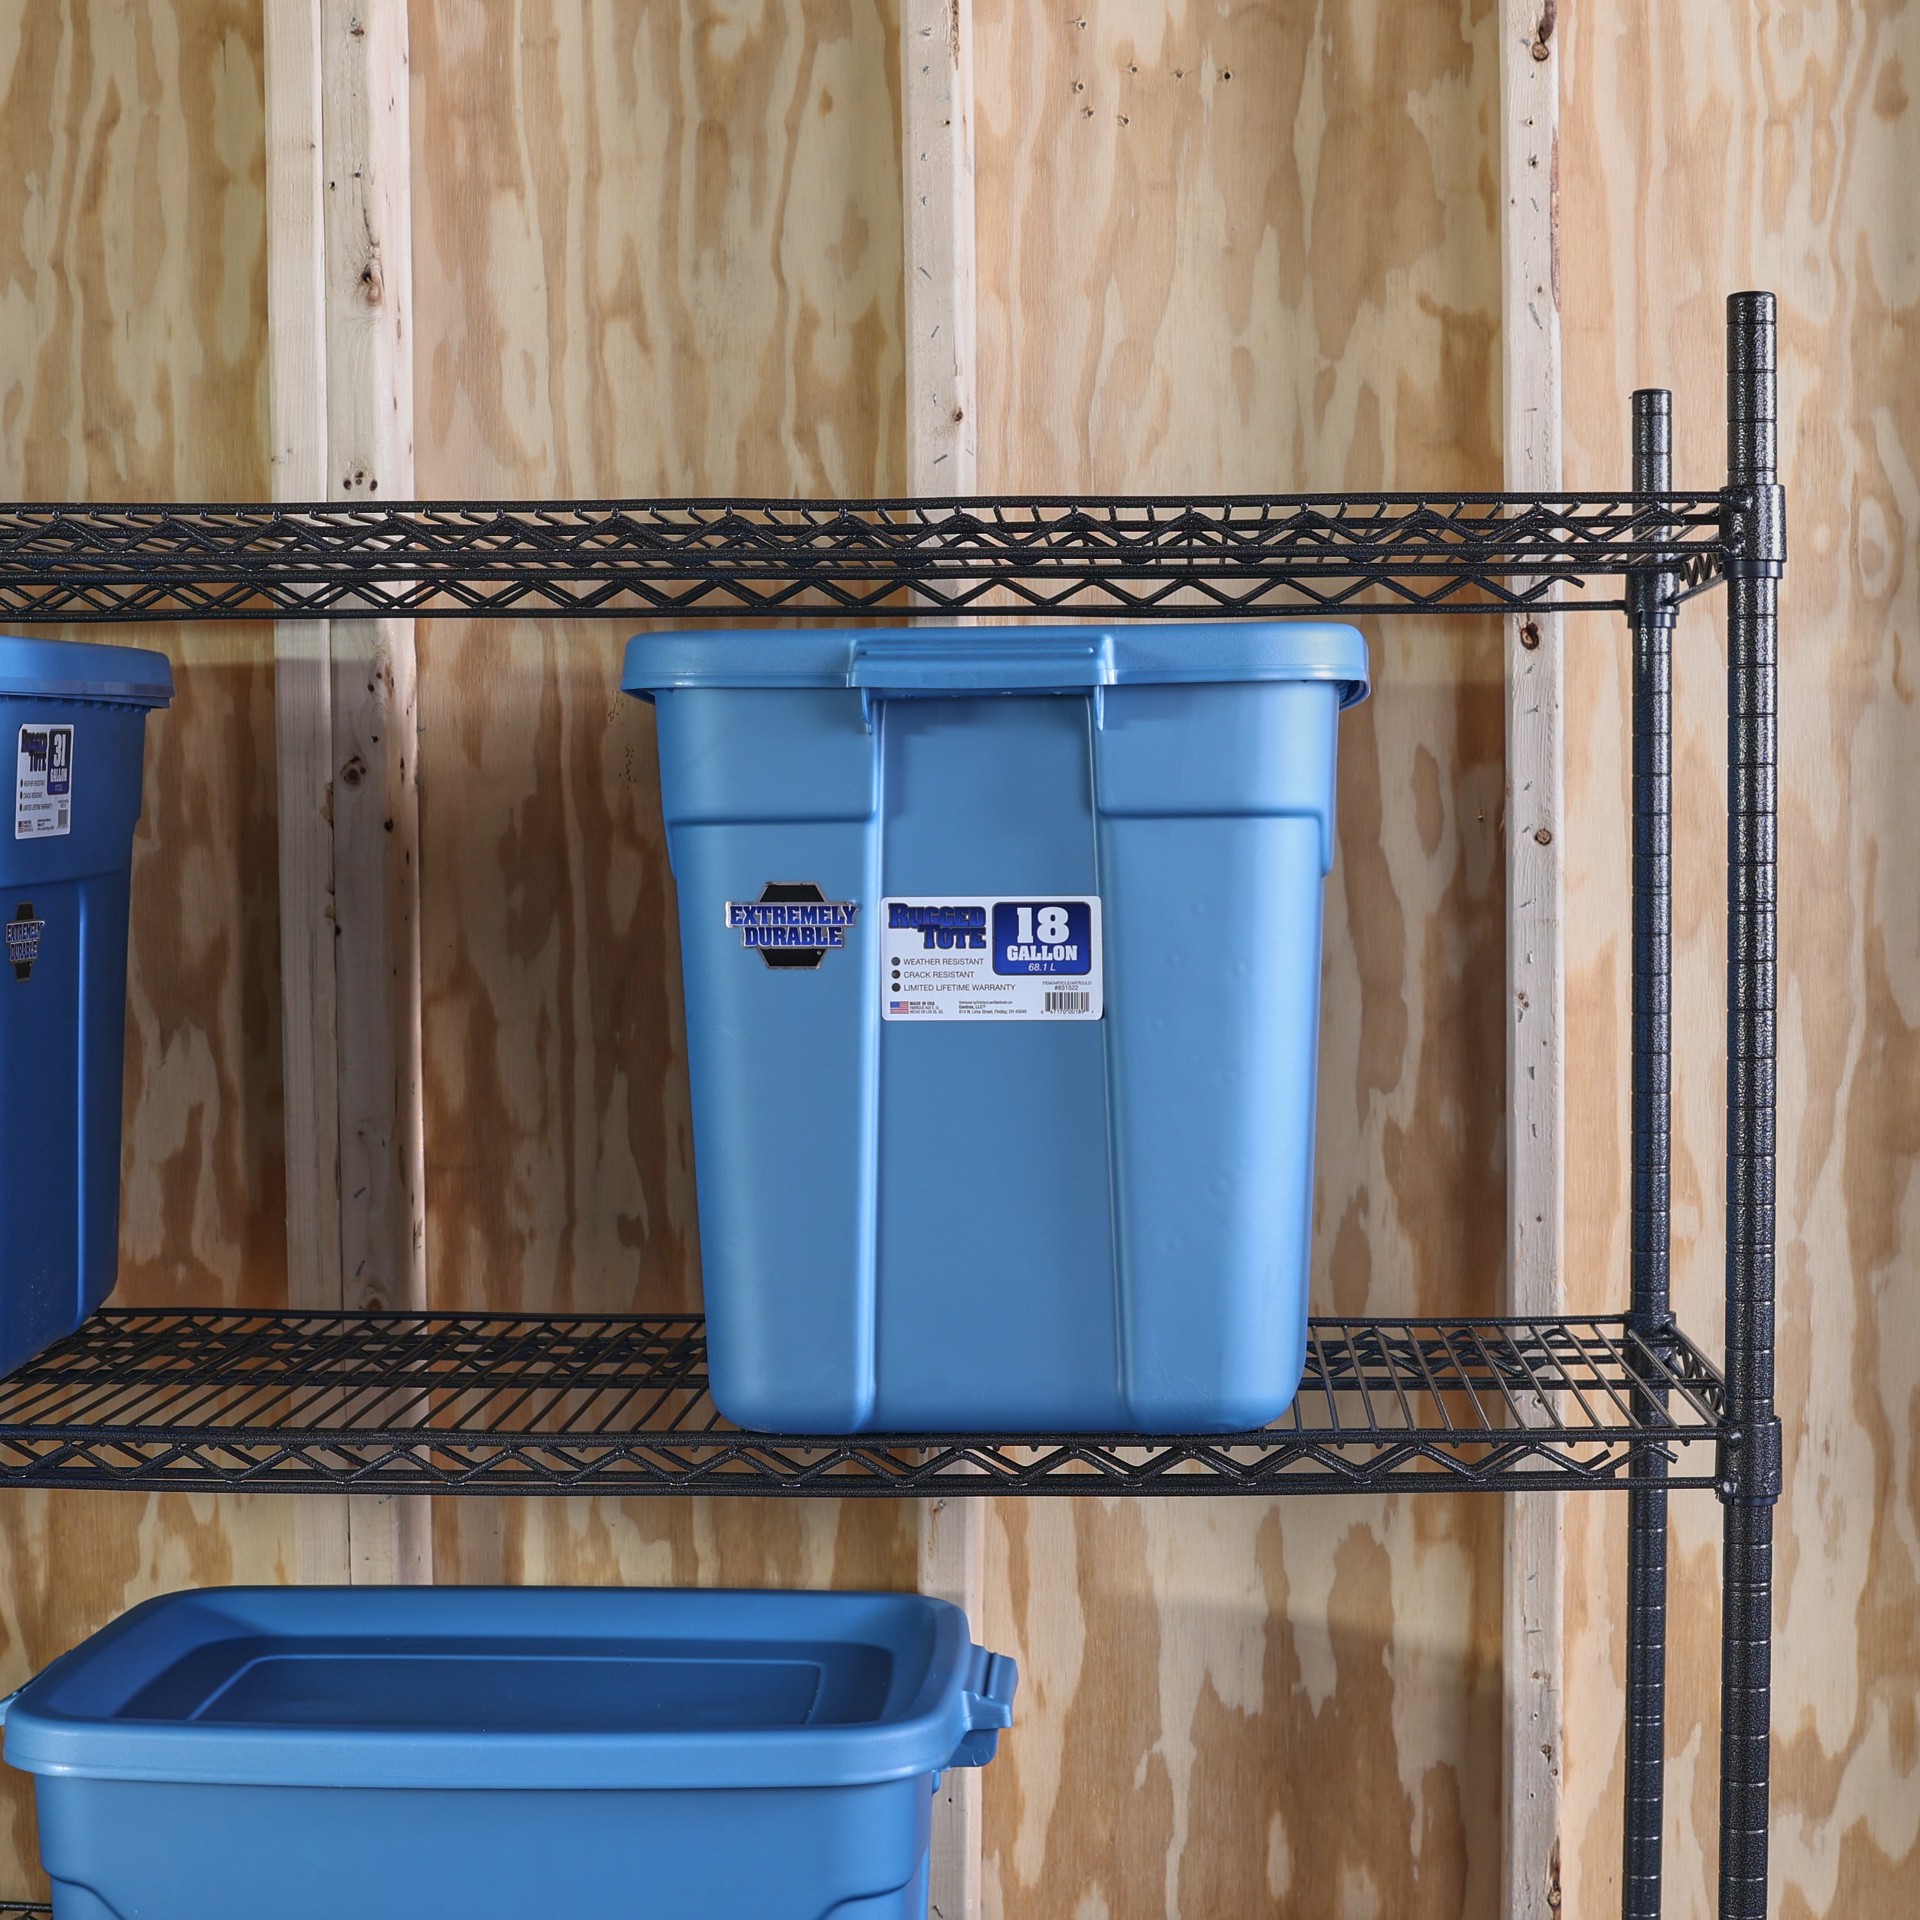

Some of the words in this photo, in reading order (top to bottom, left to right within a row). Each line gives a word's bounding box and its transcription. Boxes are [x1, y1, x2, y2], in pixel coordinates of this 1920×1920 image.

[53, 733, 67, 767] 31
[729, 905, 857, 926] EXTREMELY
[888, 903, 987, 929] RUGGED
[1016, 906, 1070, 944] 18
[6, 921, 43, 942] EXTREMELY
[744, 926, 842, 947] DURABLE
[917, 924, 987, 949] TOTE
[10, 940, 37, 961] DURABLE
[1007, 945, 1078, 961] GALLON
[903, 958, 941, 966] WEATHER
[942, 958, 984, 966] RESISTANT
[1028, 963, 1048, 972] 68.1
[1050, 963, 1056, 972] L
[903, 971, 931, 979] CRACK
[932, 971, 974, 979] RESISTANT
[903, 984, 934, 992] LIMITED
[936, 984, 970, 992] LIFETIME
[971, 984, 1016, 992] WARRANTY
